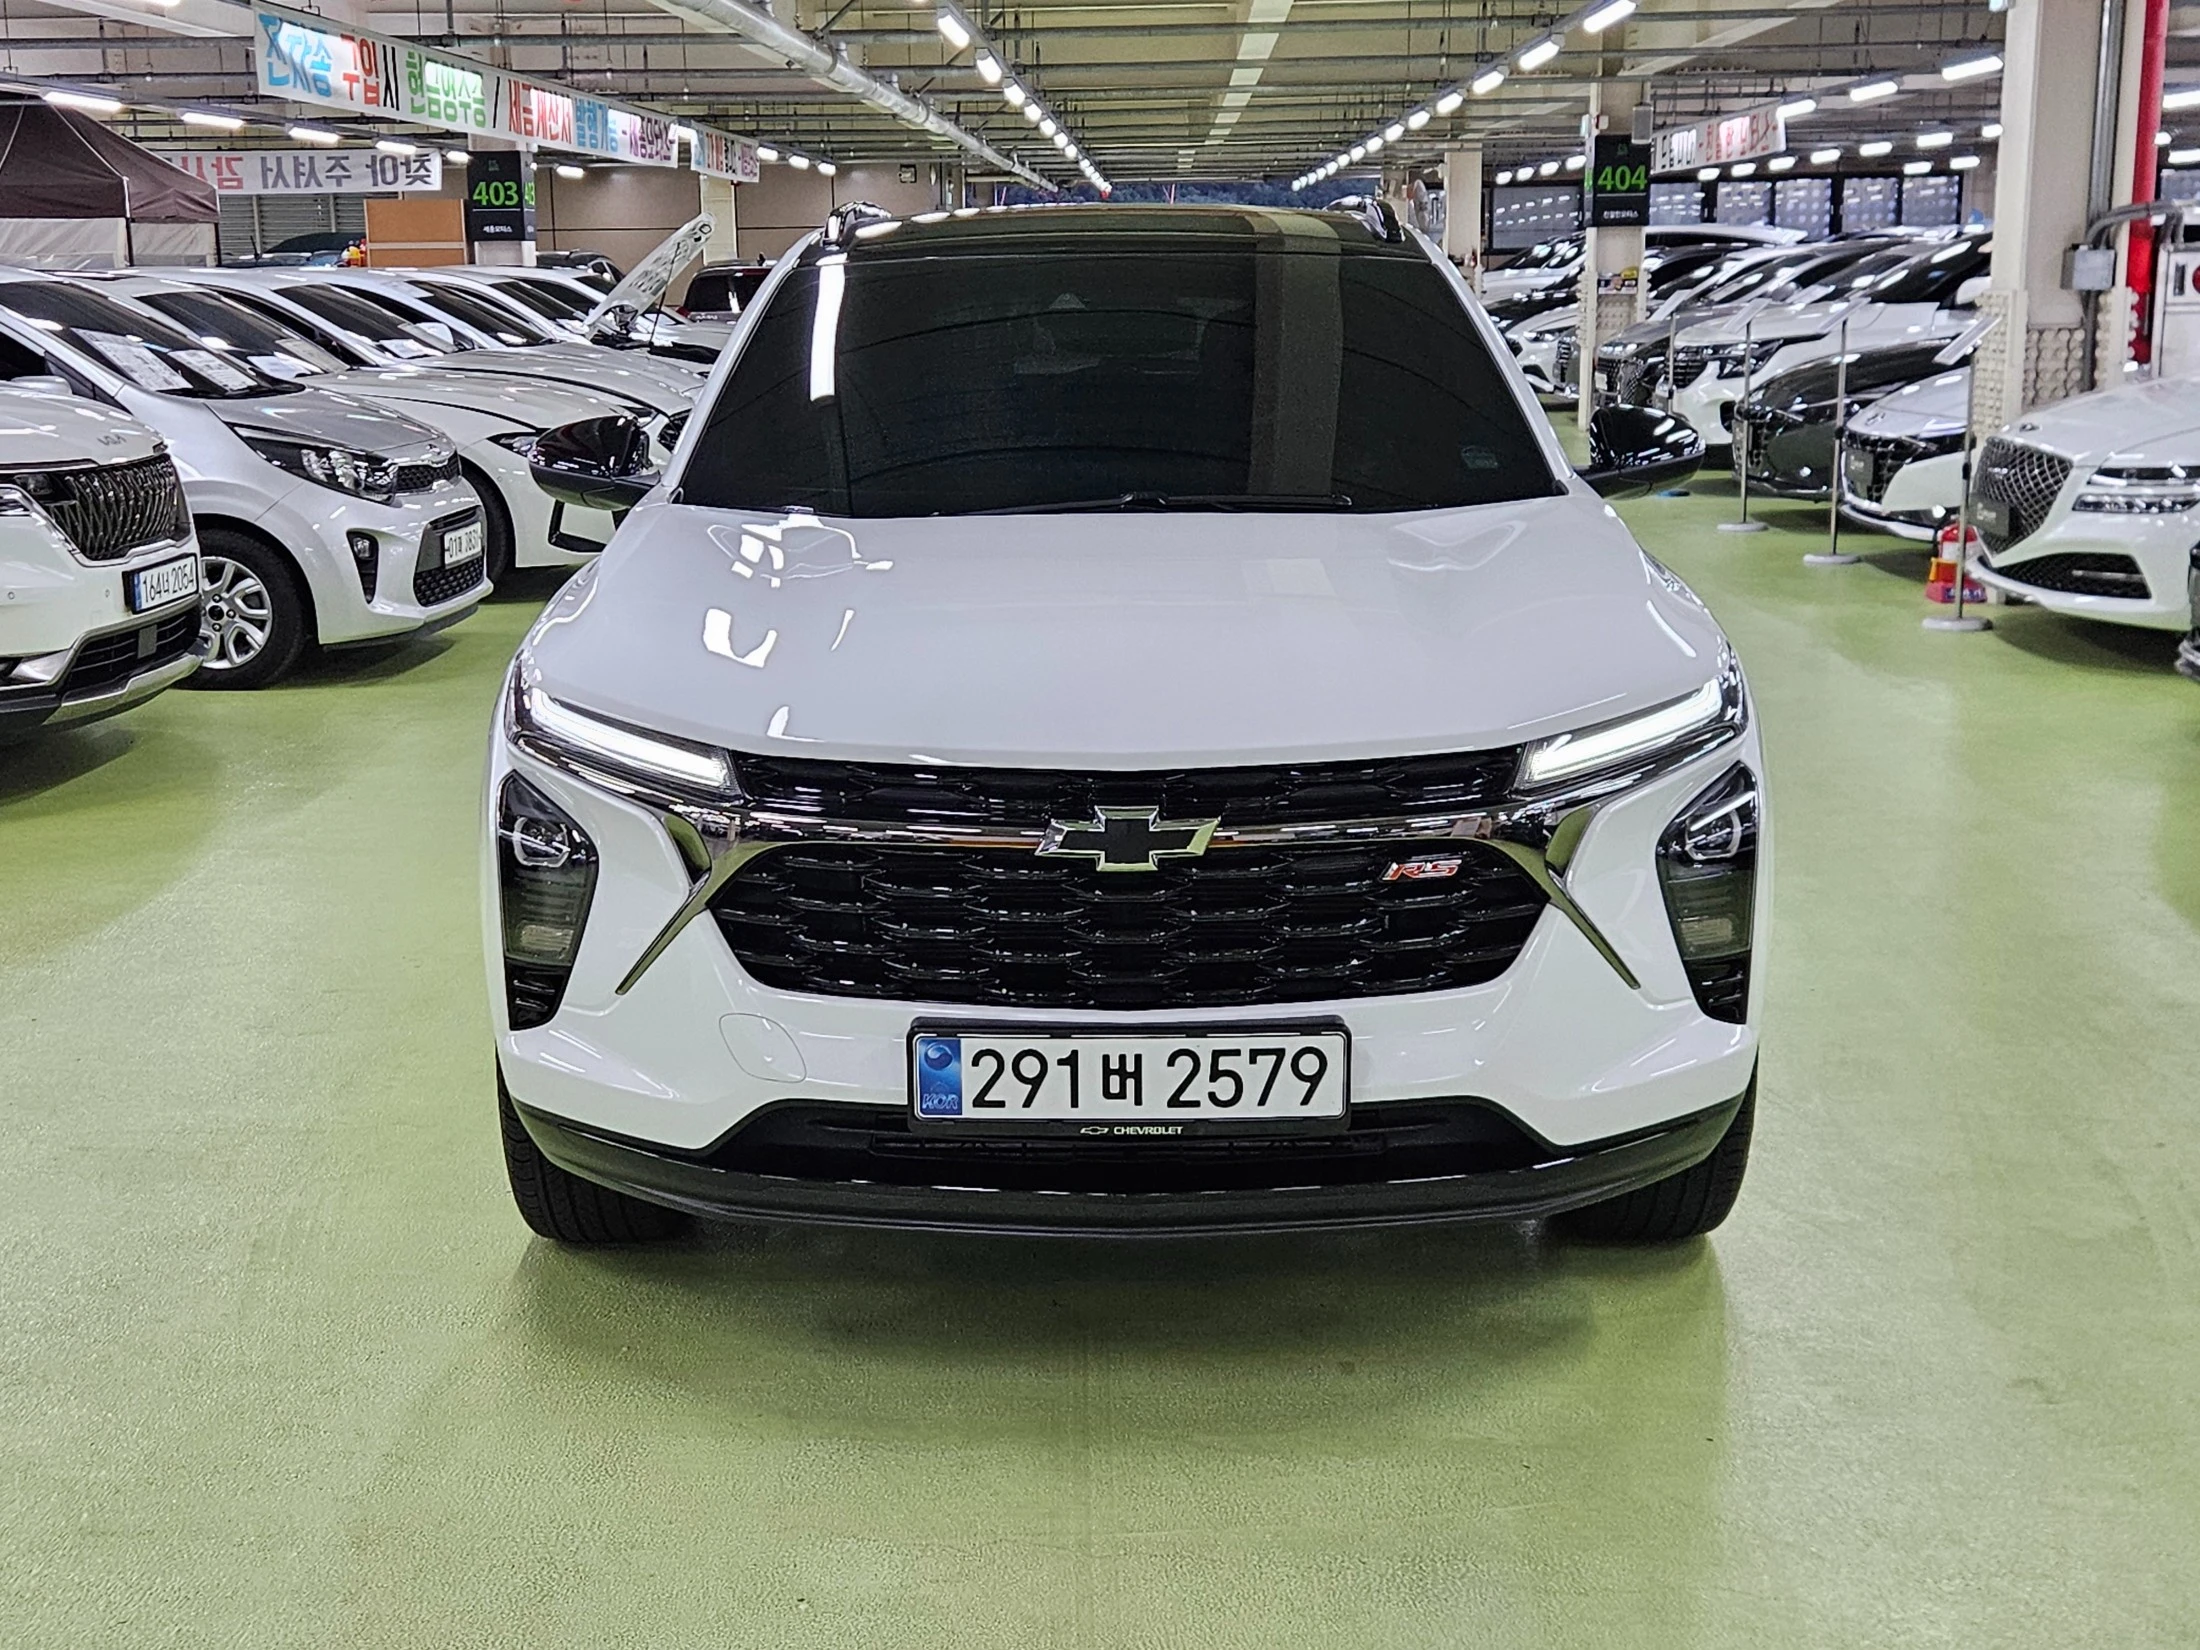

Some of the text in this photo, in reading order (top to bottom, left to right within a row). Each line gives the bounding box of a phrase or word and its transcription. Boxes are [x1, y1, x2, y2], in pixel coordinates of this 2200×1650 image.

[1597, 164, 1648, 191] 404
[472, 181, 520, 206] 403
[1382, 859, 1463, 881] RS
[1166, 1045, 1329, 1109] 2579
[921, 1093, 960, 1110] KOR
[1113, 1126, 1184, 1135] CHEVROLET
